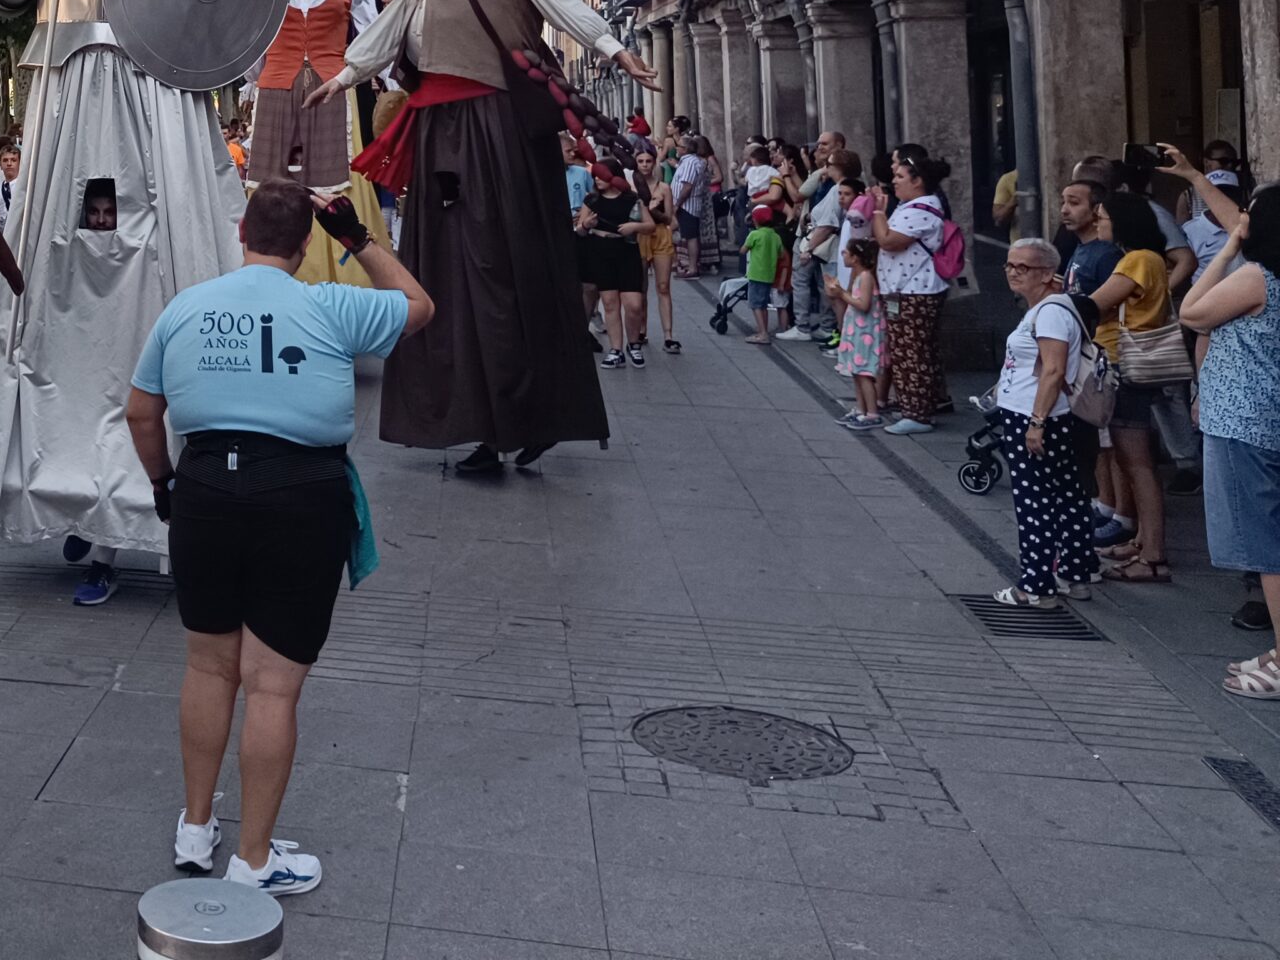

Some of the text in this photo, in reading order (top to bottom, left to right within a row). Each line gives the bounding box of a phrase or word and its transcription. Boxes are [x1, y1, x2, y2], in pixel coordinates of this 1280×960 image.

[199, 309, 255, 336] 500
[203, 336, 249, 350] AÑOS
[198, 355, 252, 367] ALCALÁ
